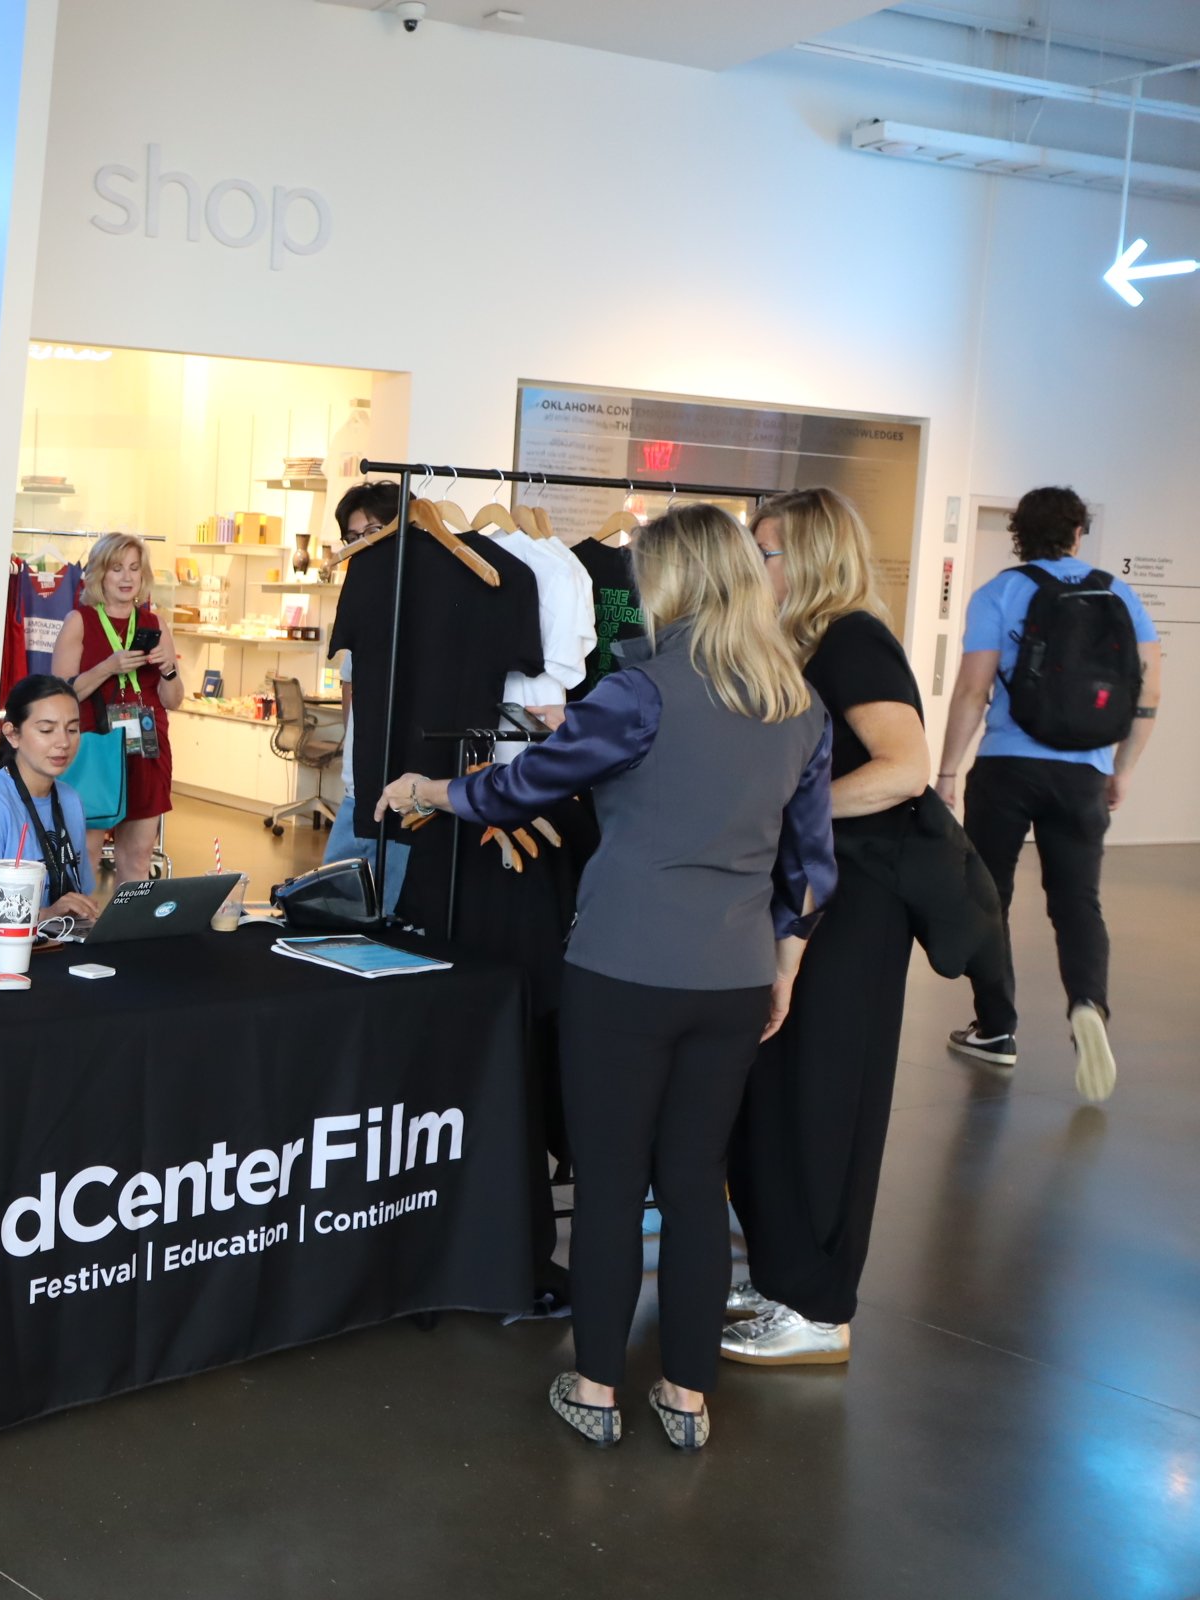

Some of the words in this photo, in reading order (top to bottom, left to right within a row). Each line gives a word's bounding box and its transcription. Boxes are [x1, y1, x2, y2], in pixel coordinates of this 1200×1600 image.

[90, 143, 334, 272] shop
[541, 400, 603, 415] OKLAHOMA
[1122, 558, 1131, 574] 3
[600, 587, 630, 606] THE
[599, 621, 620, 637] OF
[117, 889, 151, 898] AROUND
[138, 881, 155, 890] ART
[29, 1252, 137, 1304] Festival
[163, 1218, 289, 1273] Education
[314, 1189, 438, 1236] Continuum
